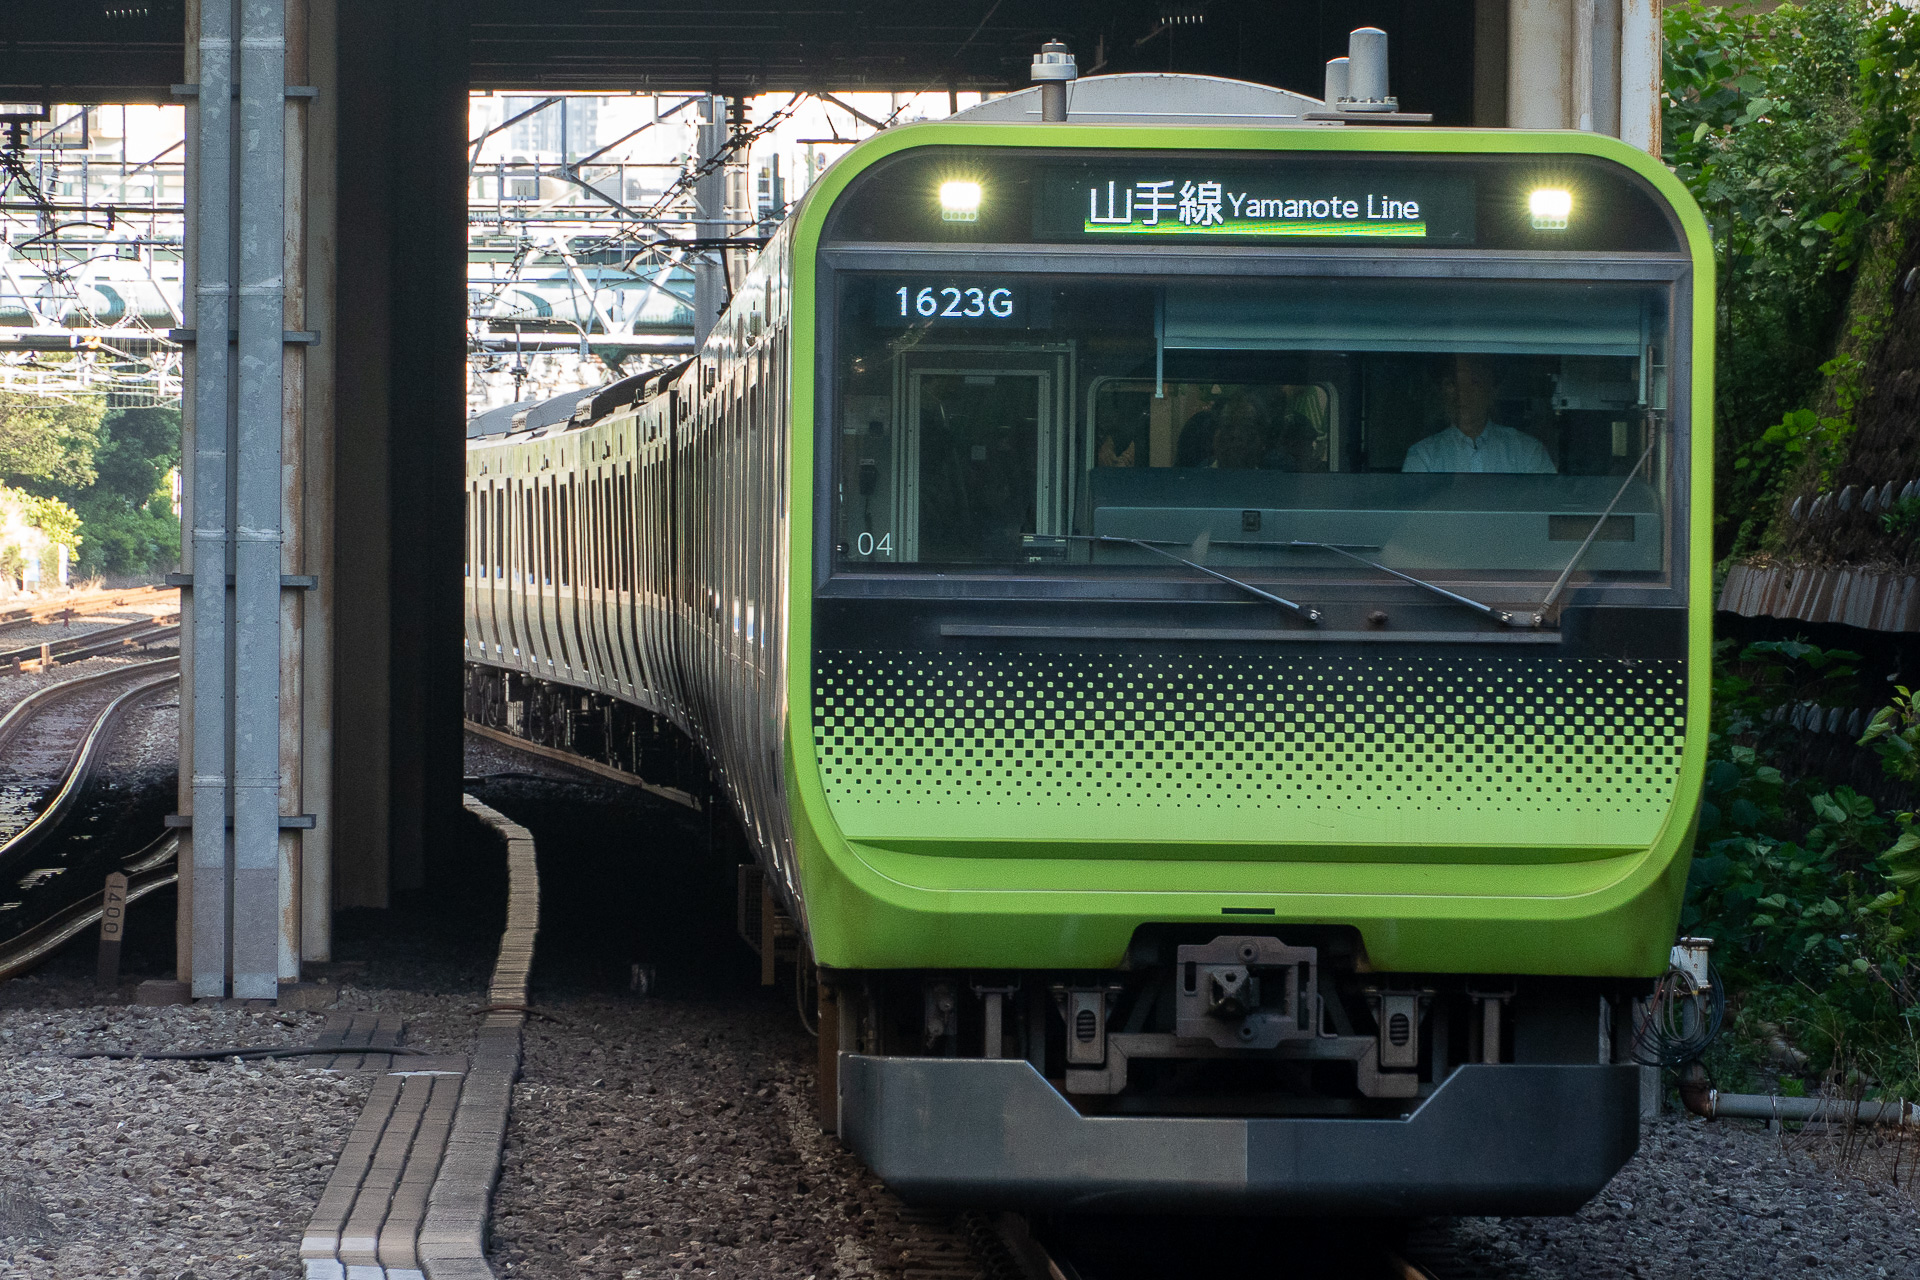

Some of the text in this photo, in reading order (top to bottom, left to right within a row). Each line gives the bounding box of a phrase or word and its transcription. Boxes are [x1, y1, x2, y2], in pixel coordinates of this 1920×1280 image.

[1090, 180, 1420, 226] 山手線 Yamanote Line
[896, 286, 1013, 318] 1623G
[857, 532, 893, 556] 04
[104, 884, 124, 934] 1400
